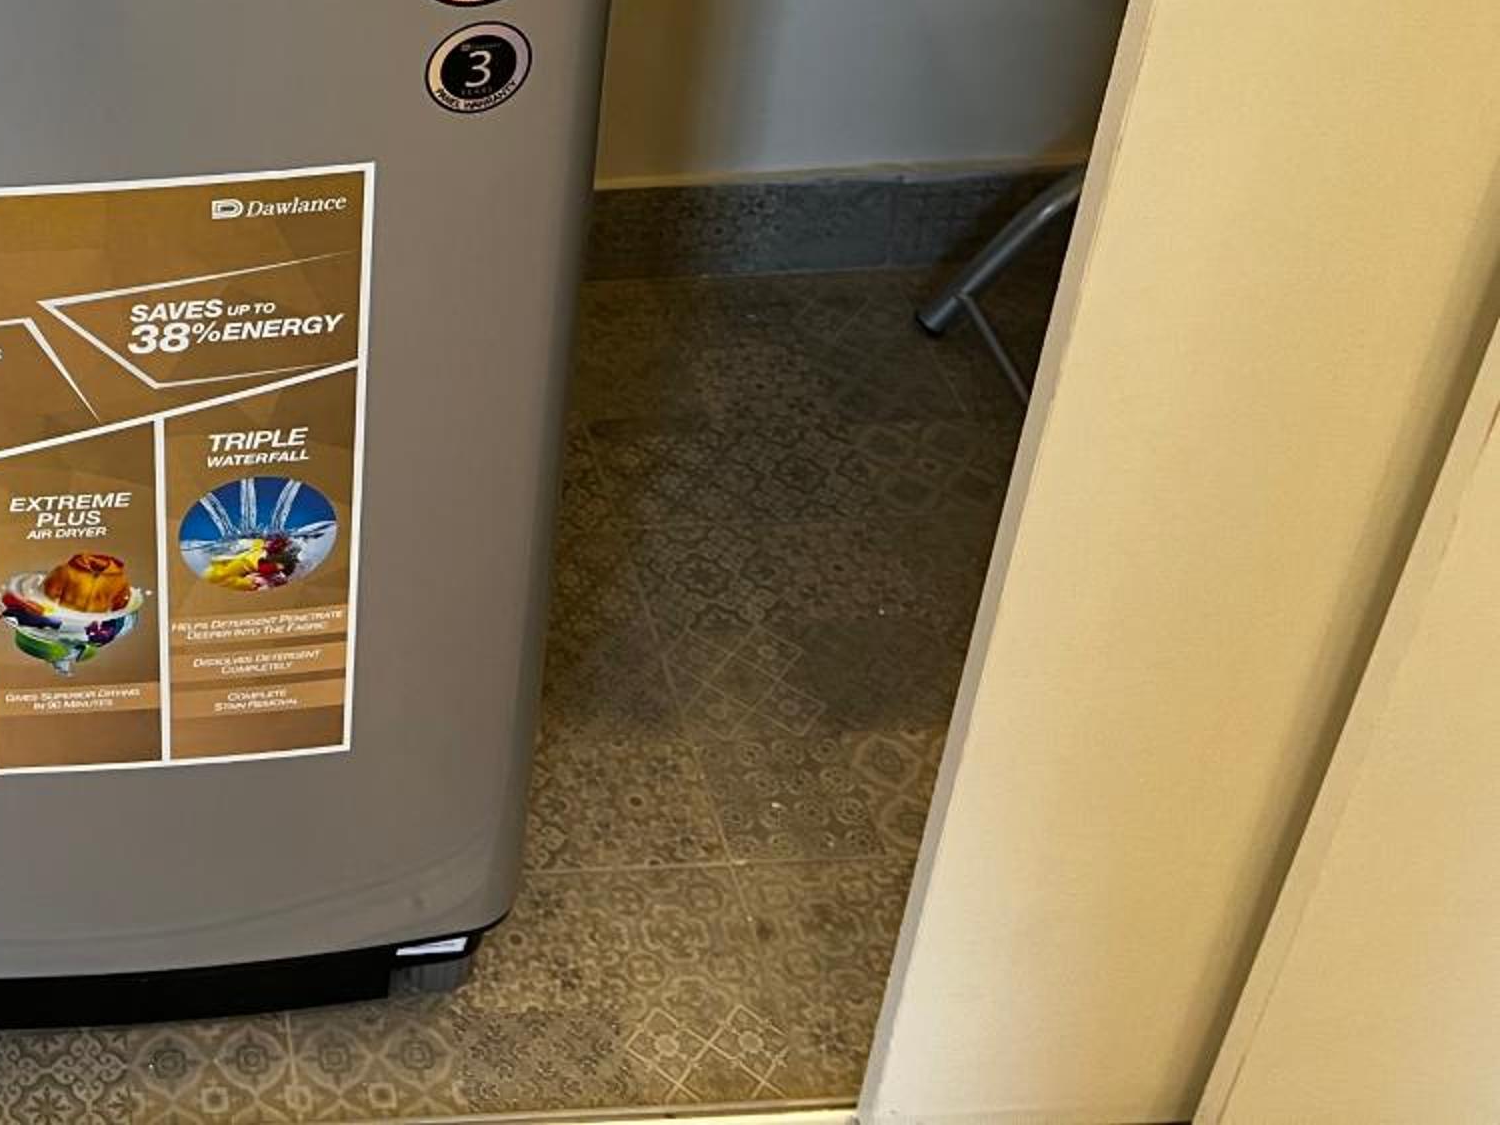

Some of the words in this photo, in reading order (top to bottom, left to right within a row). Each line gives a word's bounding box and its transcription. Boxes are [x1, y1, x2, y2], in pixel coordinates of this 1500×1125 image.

[464, 50, 492, 89] 3
[245, 196, 348, 218] Dawlance
[130, 298, 224, 323] SAVES
[227, 304, 251, 317] UP
[253, 302, 277, 315] TO
[127, 321, 221, 355] 38%
[222, 313, 345, 342] ENERGY
[208, 426, 309, 453] TRIPLE
[206, 448, 310, 468] WATERFALL
[9, 491, 133, 513] EXTREME
[36, 509, 102, 528] PLUS
[26, 528, 53, 540] AIR
[54, 526, 109, 539] DRYER
